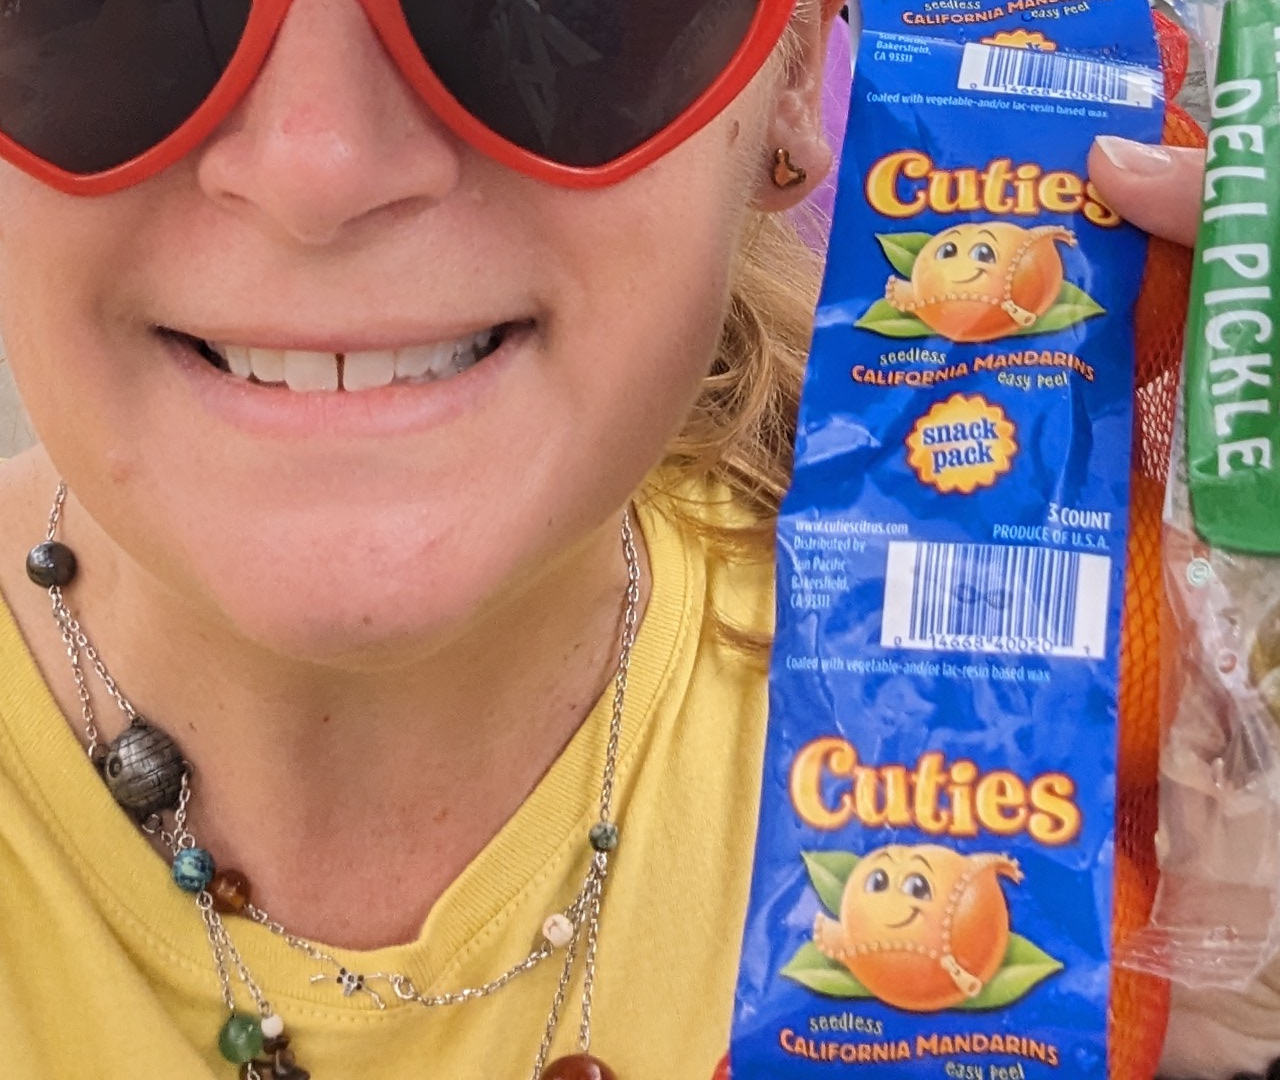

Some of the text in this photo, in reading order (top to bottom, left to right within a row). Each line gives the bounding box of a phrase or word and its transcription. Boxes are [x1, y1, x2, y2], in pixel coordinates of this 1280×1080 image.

[902, 5, 1005, 25] CALIFORNIA
[1030, 6, 1059, 21] easy
[866, 92, 899, 104] Coated
[902, 93, 923, 105] with
[1057, 103, 1086, 116] based
[1087, 108, 1109, 119] wax
[1203, 78, 1273, 477] DELI PICKLE
[880, 347, 947, 366] seedless
[851, 350, 1095, 389] CALIFORNIA MANDARINS
[998, 371, 1032, 390] easy
[922, 418, 998, 446] snack
[932, 446, 995, 474] pack
[795, 519, 908, 535] www.cutiescitrus.com
[1048, 502, 1112, 530] 3 COUNT
[794, 535, 867, 553] Distributed by
[993, 524, 1111, 549] PRODUCE OF U.S.A.
[994, 637, 1053, 653] 40020
[786, 655, 818, 670] Coated
[820, 656, 844, 671] with
[992, 664, 1024, 680] based
[1027, 670, 1051, 682] wax
[789, 735, 1081, 847] Cuties
[809, 1011, 884, 1036] seedless
[779, 1026, 1059, 1067] CALIFORNIA MANDARINS
[944, 1060, 984, 1080] easy
